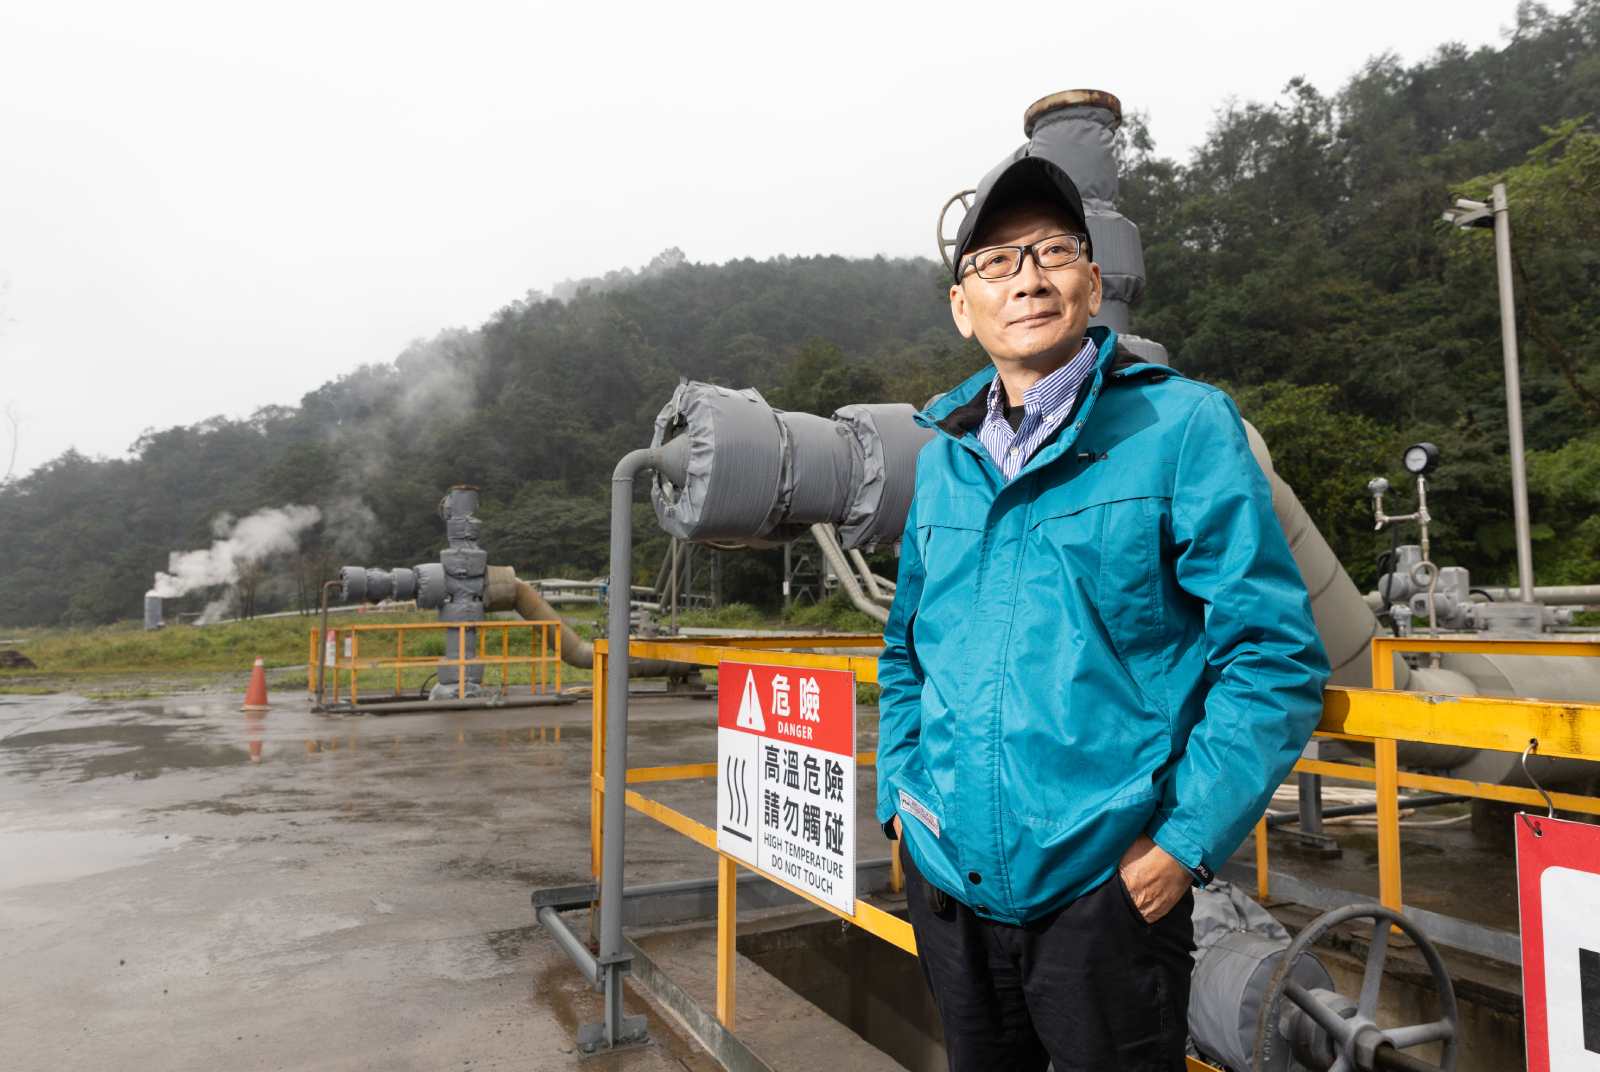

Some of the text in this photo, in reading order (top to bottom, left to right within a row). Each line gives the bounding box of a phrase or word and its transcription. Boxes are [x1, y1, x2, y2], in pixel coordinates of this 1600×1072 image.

[771, 673, 820, 723] 危險
[778, 722, 813, 740] DANGER
[764, 745, 844, 803] 高溫危險
[764, 789, 844, 857] 請勿觸碰
[764, 833, 844, 879] HIGH TEMPERATURE
[772, 854, 833, 894] DO NOT TOUCH
